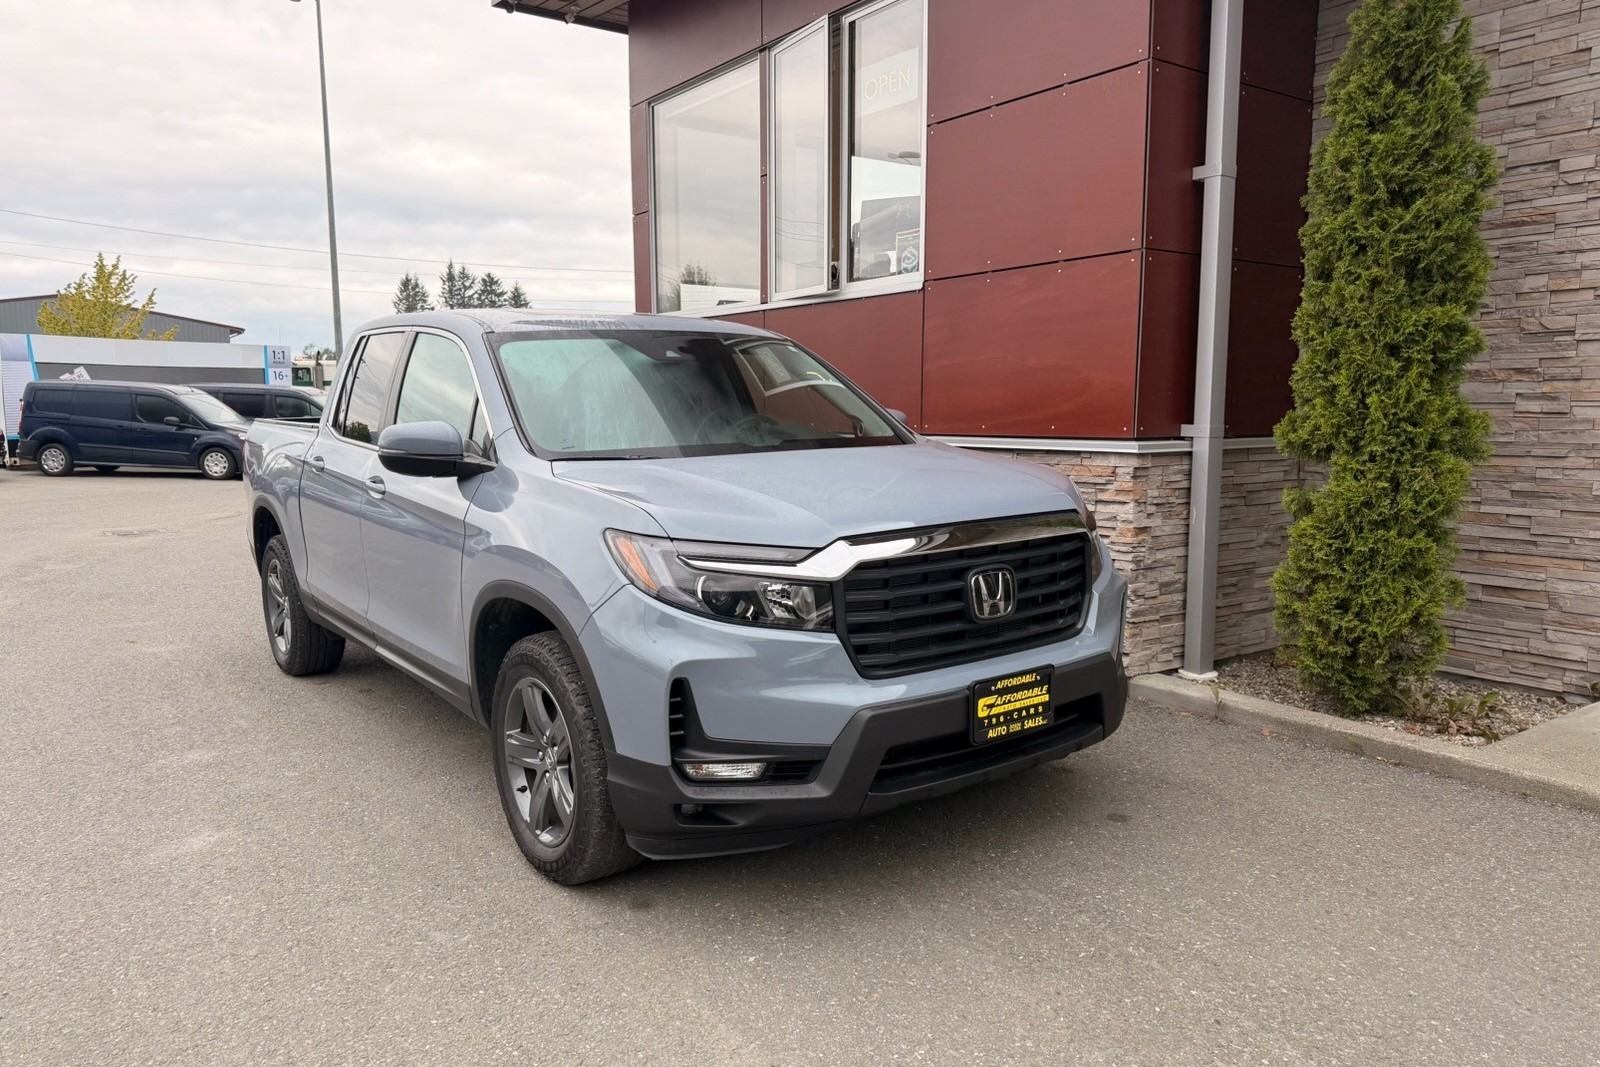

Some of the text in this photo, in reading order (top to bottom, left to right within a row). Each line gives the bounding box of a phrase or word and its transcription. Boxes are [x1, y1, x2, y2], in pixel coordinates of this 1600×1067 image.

[865, 64, 912, 100] OPEN
[272, 350, 285, 360] 1:1
[273, 370, 288, 381] 16+
[996, 673, 1037, 689] AFFORDABLE
[995, 685, 1048, 706] AFFORDABLE
[987, 726, 1007, 739] AUTO
[1023, 716, 1043, 729] SALES
